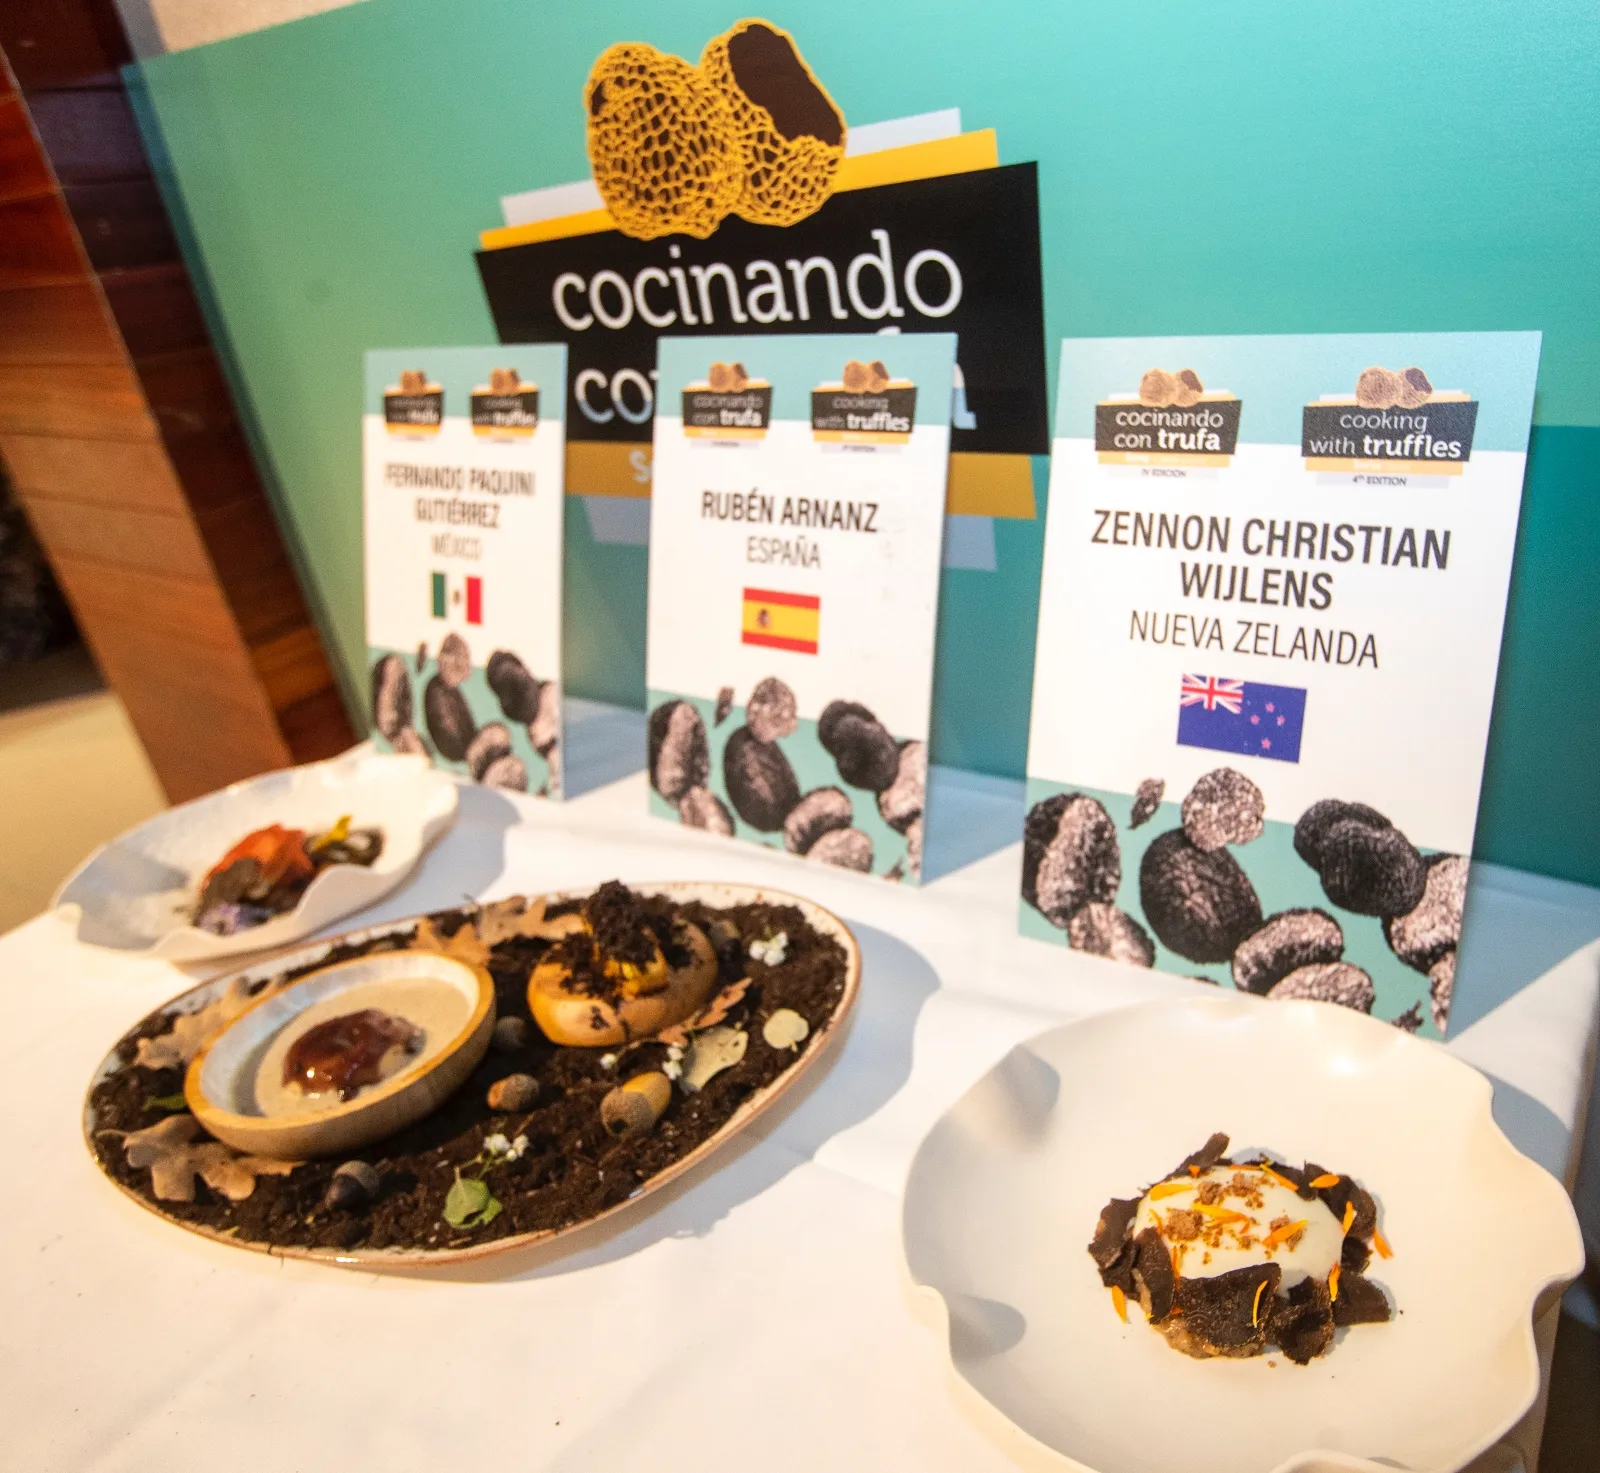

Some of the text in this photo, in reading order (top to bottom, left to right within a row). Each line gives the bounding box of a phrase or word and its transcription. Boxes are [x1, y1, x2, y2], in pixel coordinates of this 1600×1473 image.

[552, 229, 962, 331] cocinando
[574, 367, 656, 424] co
[693, 393, 763, 409] cocinando
[832, 396, 889, 412] cooking
[691, 408, 763, 427] con trufa
[847, 411, 910, 432] truffles
[1115, 409, 1224, 428] cocinando
[1339, 411, 1429, 434] cooking
[1113, 428, 1221, 450] con trufa
[1309, 434, 1462, 458] with truffles
[384, 463, 536, 497] FERNANDO PAQUINI
[1366, 476, 1407, 486] EDITION
[415, 495, 501, 529] GUTIÉRREZ
[702, 487, 879, 533] RUBÉN ARNANZ
[747, 534, 821, 569] ESPAÑA
[1091, 509, 1451, 570] ZENNON CHRISTIAN
[1180, 561, 1333, 611] WIJLENS
[1129, 610, 1379, 670] NUEVA ZELANDA
